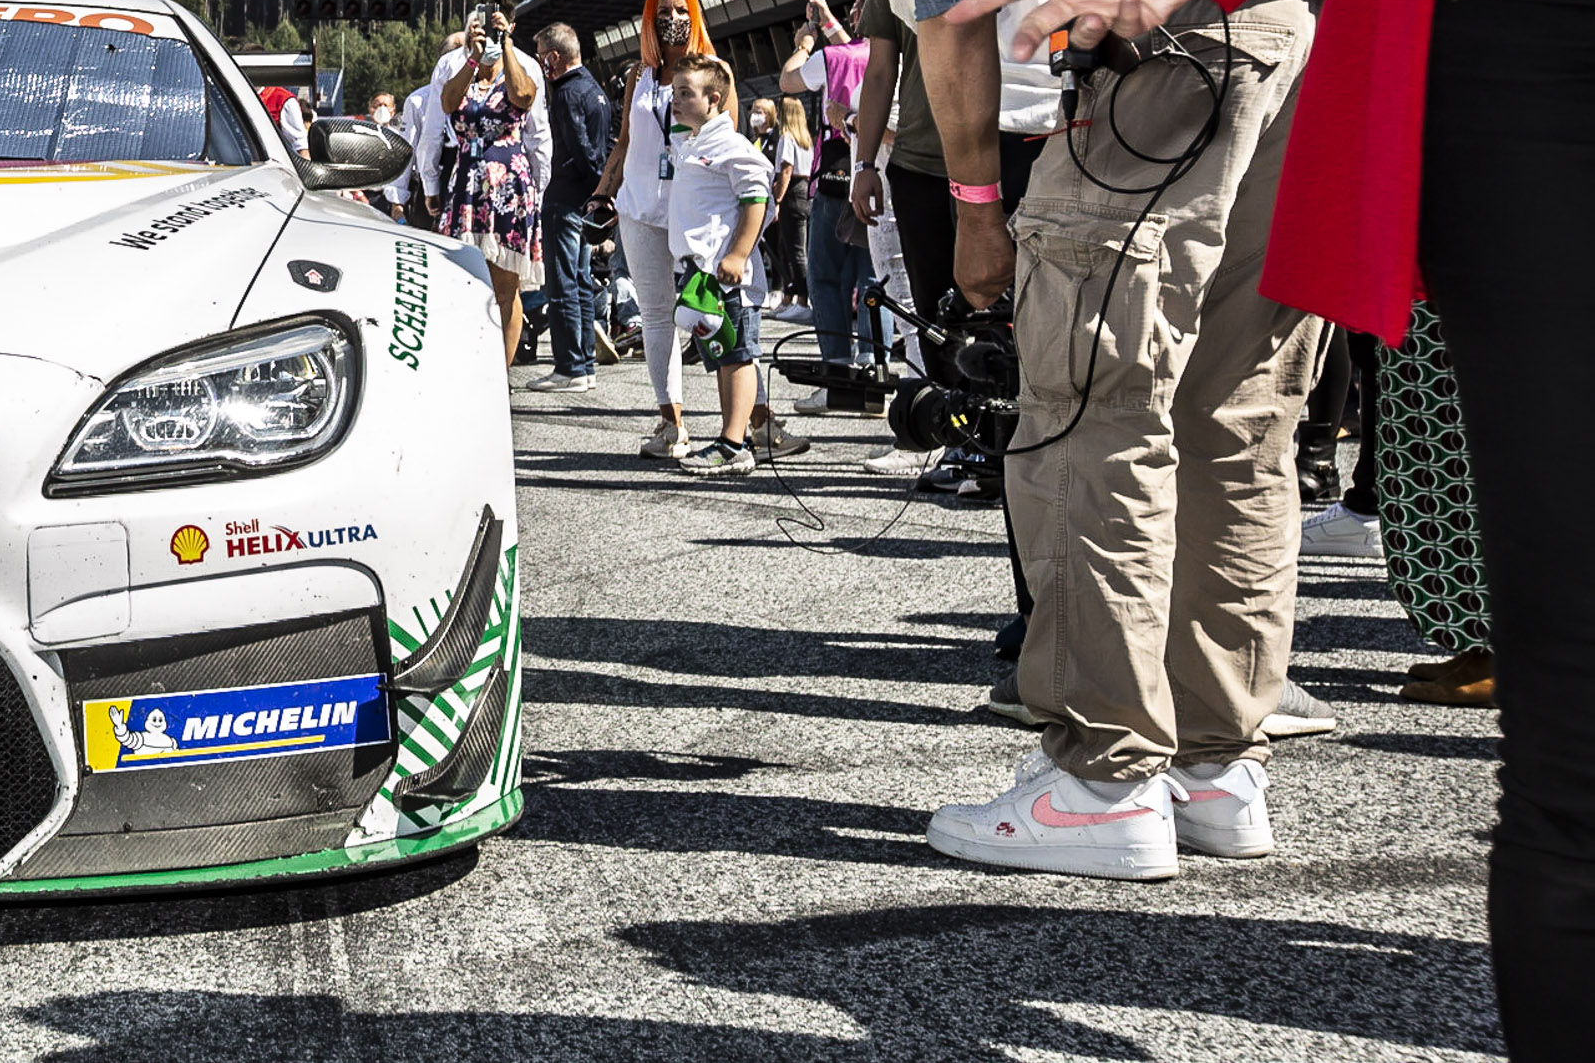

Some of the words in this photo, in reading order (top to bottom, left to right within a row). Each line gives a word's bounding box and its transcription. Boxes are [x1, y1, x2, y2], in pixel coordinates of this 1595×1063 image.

[108, 230, 168, 250] We
[151, 203, 214, 233] stand
[388, 240, 428, 371] SCHAEFFLER
[225, 519, 260, 536] Shell
[225, 525, 308, 558] HELIX
[307, 524, 378, 549] ULTRA
[181, 700, 358, 742] MICHELIN
